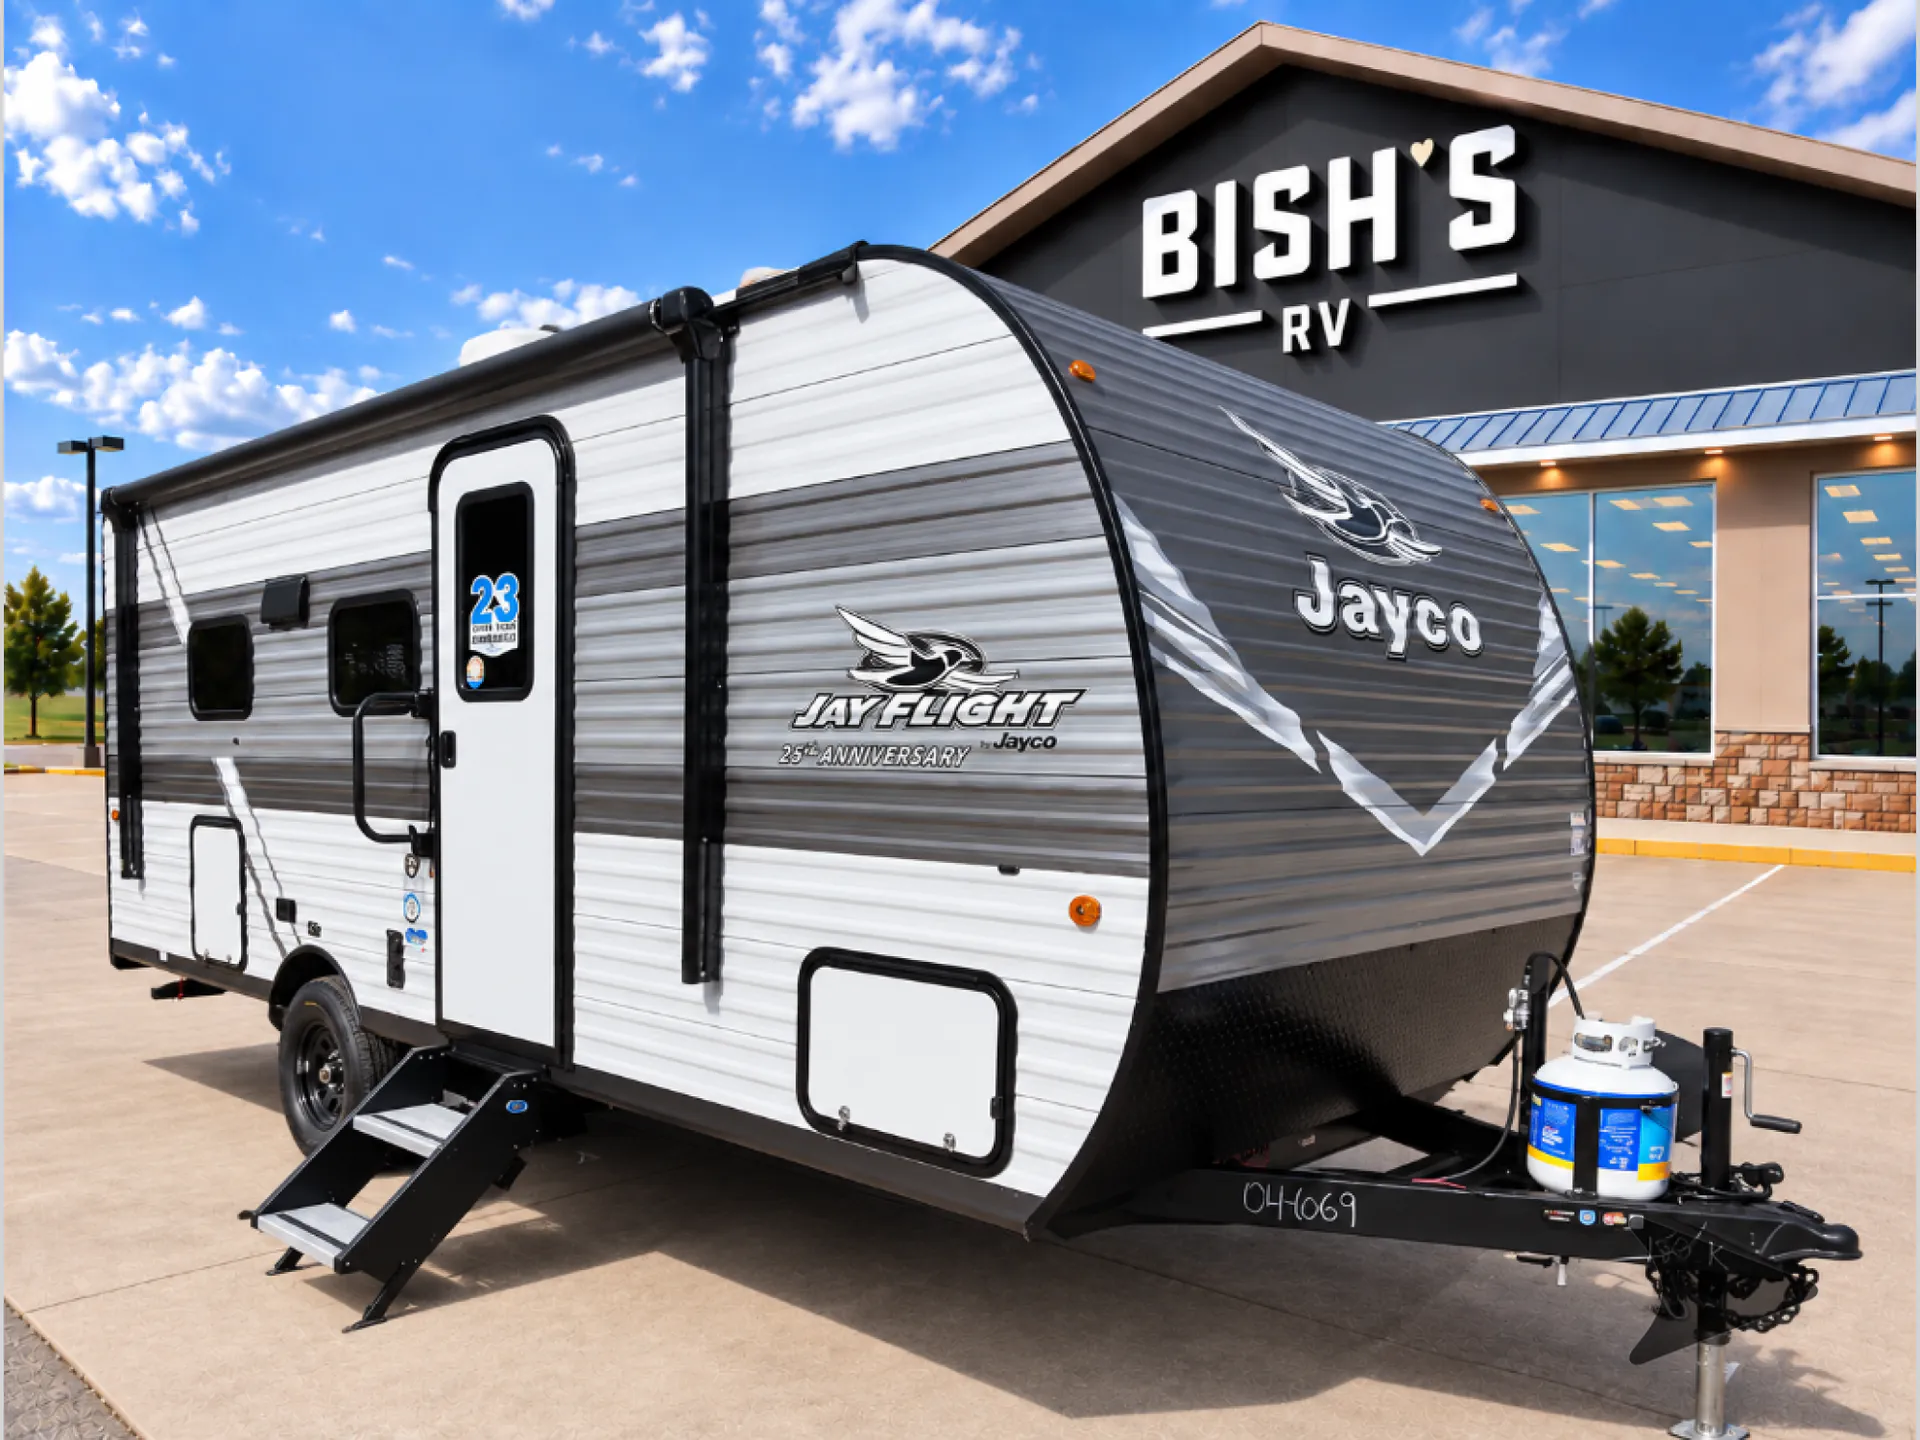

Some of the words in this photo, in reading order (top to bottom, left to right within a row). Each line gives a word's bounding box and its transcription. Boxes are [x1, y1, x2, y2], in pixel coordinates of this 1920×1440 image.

[1282, 298, 1351, 354] RV
[470, 571, 520, 625] 23
[1293, 552, 1484, 661] Jayco
[790, 691, 882, 730] JAY
[874, 687, 1090, 731] FLIGHT
[817, 744, 972, 769] ANNIVERSARY
[993, 731, 1058, 753] Jayco
